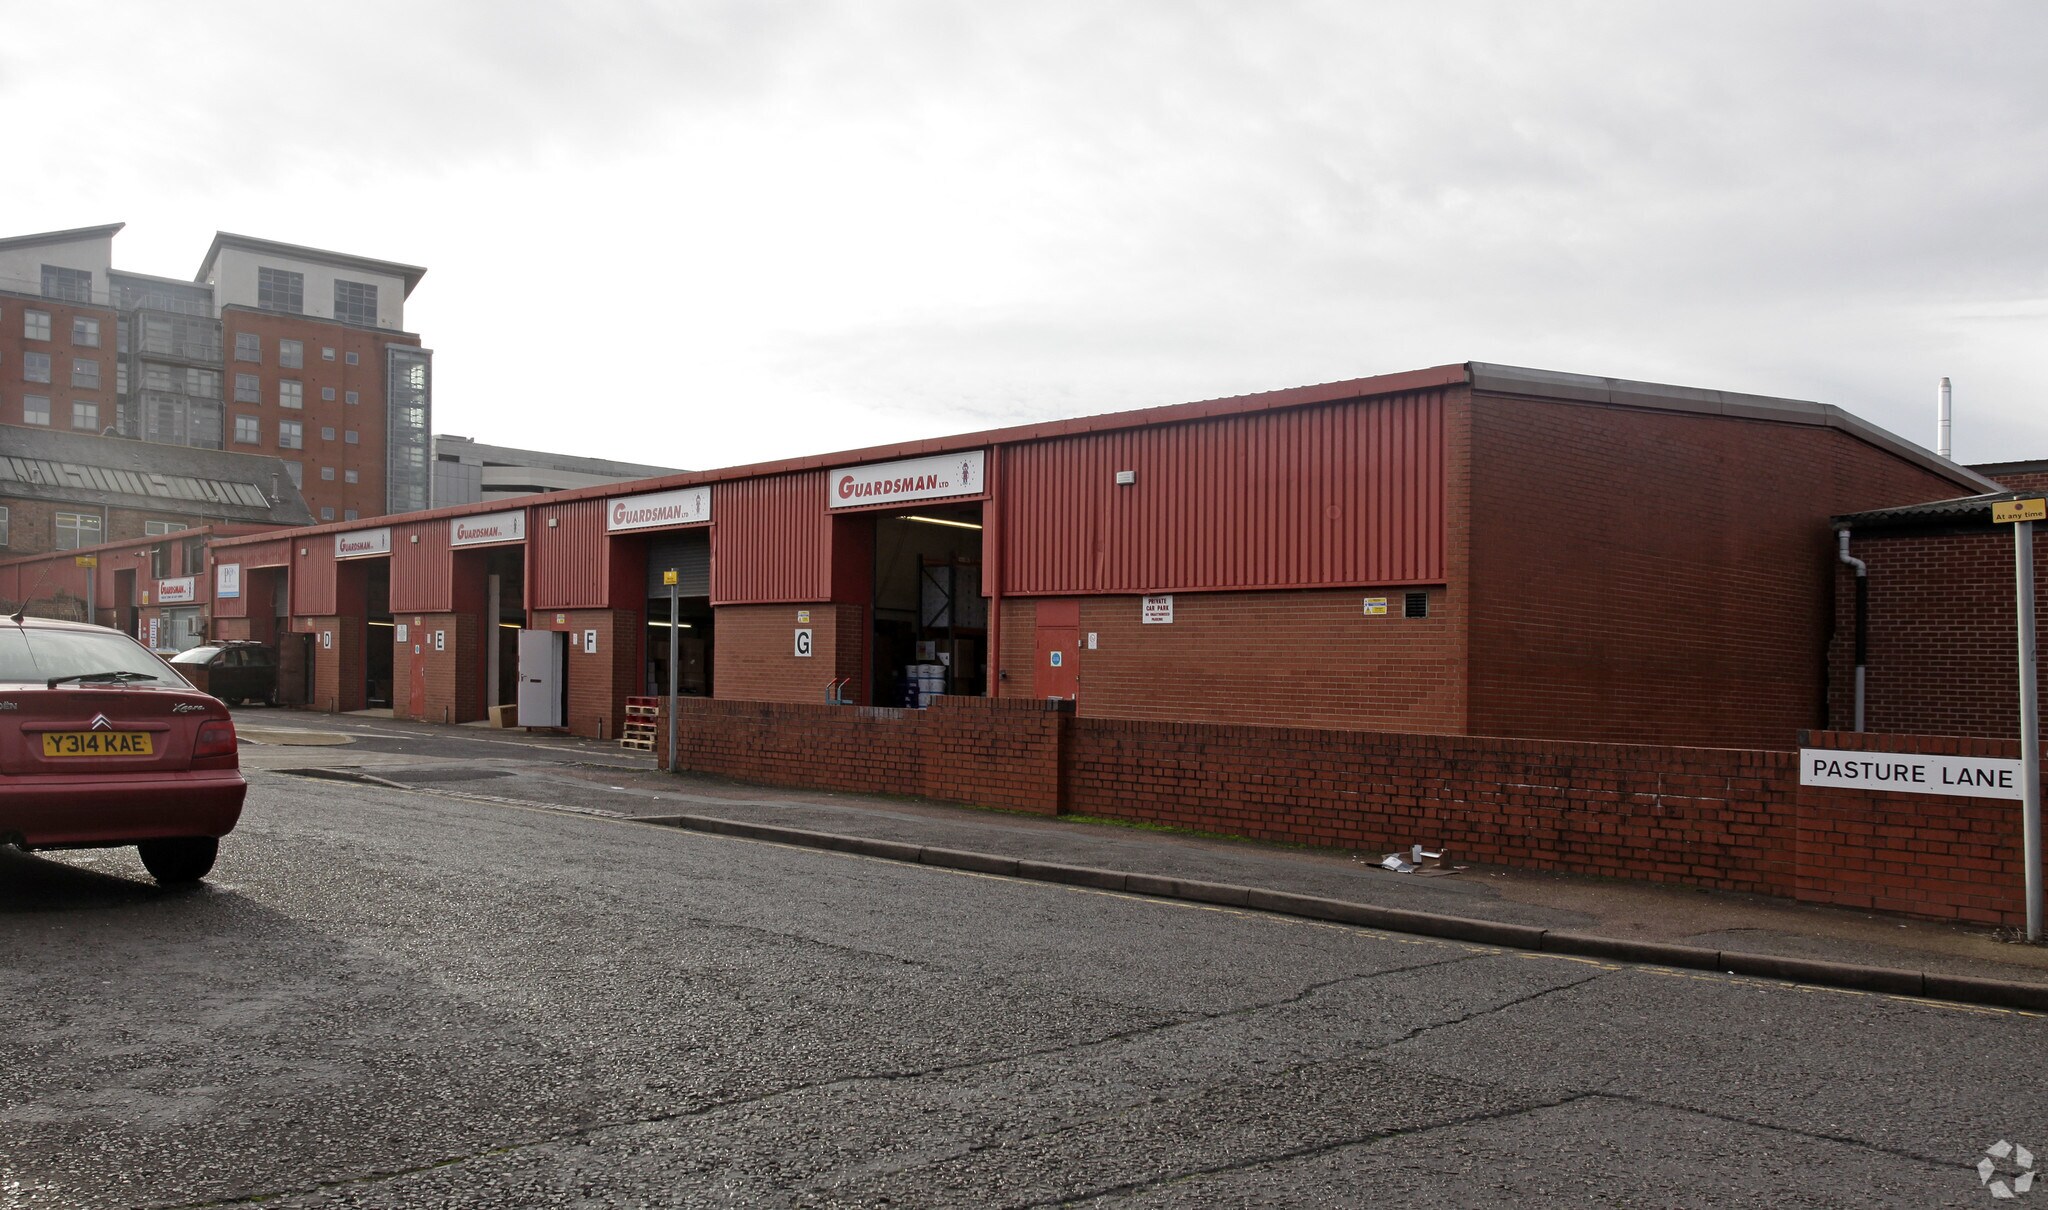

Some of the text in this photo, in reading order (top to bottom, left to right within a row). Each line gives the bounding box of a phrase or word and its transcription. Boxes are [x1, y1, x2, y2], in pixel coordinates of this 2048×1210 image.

[838, 474, 949, 499] GUARDSMAN LTD
[613, 502, 682, 525] GUARDSMAN
[457, 524, 498, 540] GUARDSMAN
[325, 633, 330, 647] D
[437, 632, 443, 648] E
[587, 632, 594, 650] F
[797, 631, 809, 654] G
[172, 702, 205, 713] Xsara
[50, 735, 145, 753] Y314 KAE
[1813, 759, 2013, 789] PASTURE LANE
